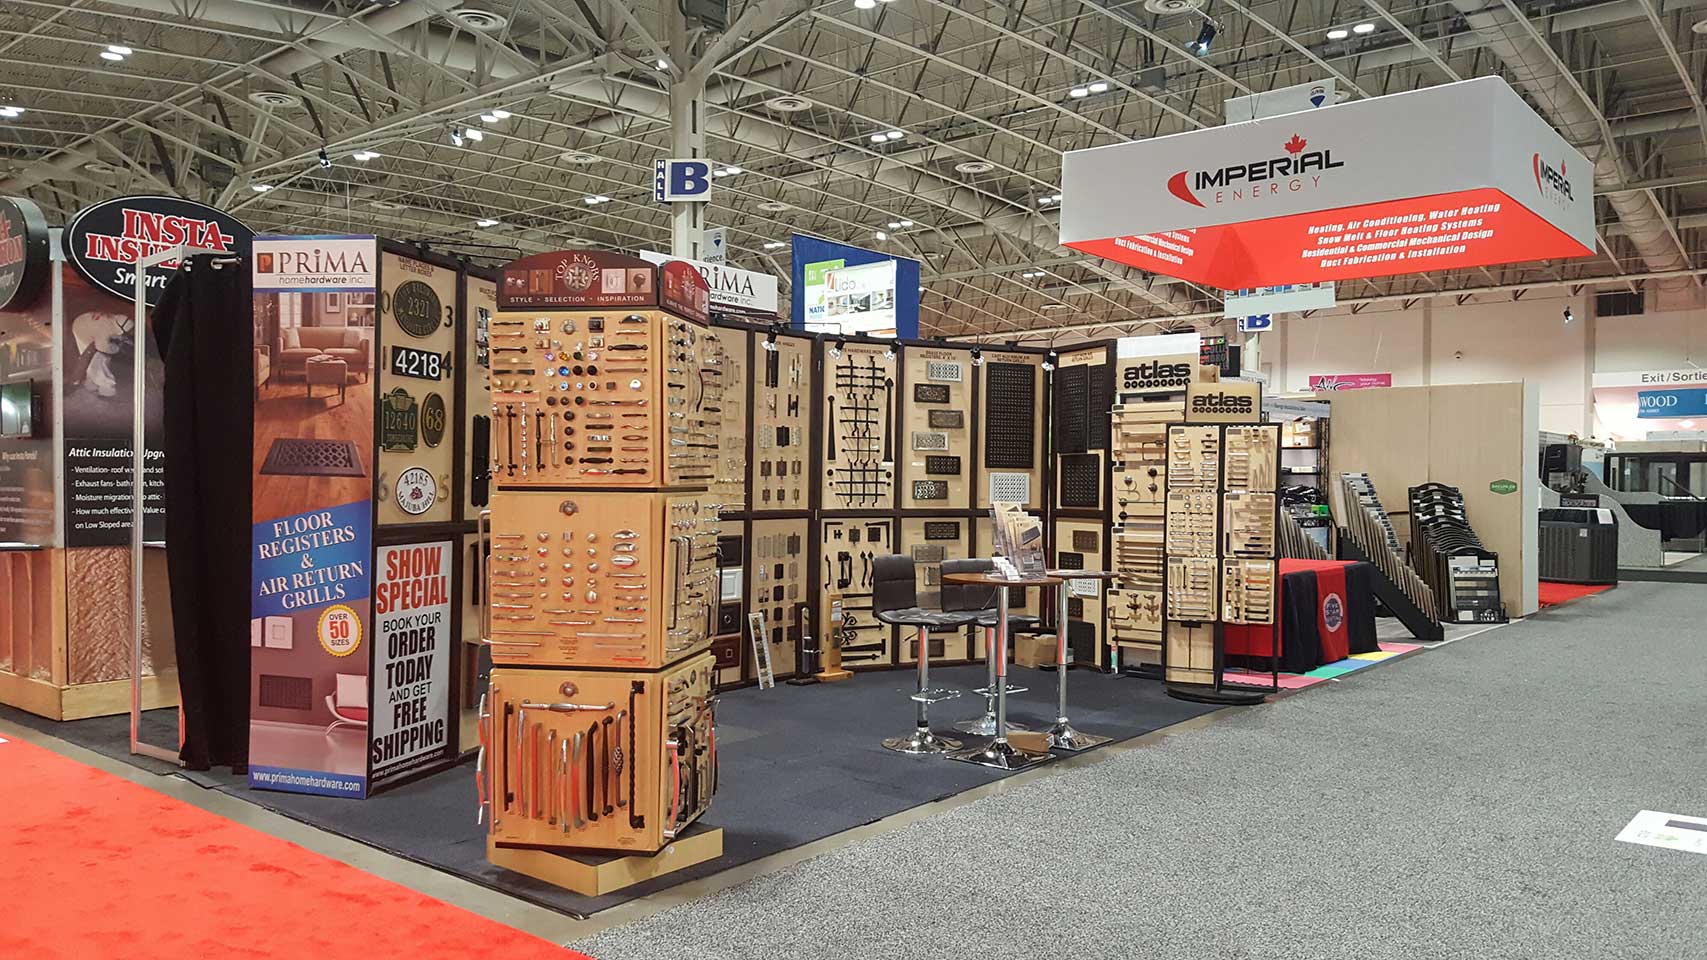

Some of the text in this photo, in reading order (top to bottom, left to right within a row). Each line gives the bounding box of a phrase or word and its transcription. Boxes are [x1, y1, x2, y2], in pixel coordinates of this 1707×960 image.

[656, 161, 664, 200] HALL
[671, 162, 709, 195] B
[1216, 176, 1320, 203] ENERGY
[122, 208, 234, 251] INSTA-
[1308, 203, 1500, 234] Heating, Air Conditioning, Water Heating
[1317, 218, 1482, 245] Snow Melt & Floor Heating Systems
[1302, 246, 1348, 258] Residential
[1357, 239, 1407, 252] Commercial
[1409, 232, 1460, 246] Mechanical
[1461, 229, 1494, 241] Design
[1320, 244, 1466, 268] Duct Fabrication & Installation
[114, 268, 167, 288] Smart
[279, 276, 347, 286] homehardware
[555, 254, 600, 281] TOP KNOBS
[408, 296, 430, 318] 2321
[444, 306, 453, 327] 3
[1248, 314, 1271, 328] B
[396, 350, 440, 377] 4218
[441, 351, 452, 378] 4
[1124, 360, 1190, 380] atlas
[1192, 392, 1252, 407] atlas
[426, 408, 444, 431] 68
[68, 448, 91, 457] Attic
[92, 448, 134, 458] Insulatio
[404, 472, 428, 486] 42185
[438, 474, 449, 502] 5
[99, 521, 120, 530] Sloped
[273, 512, 334, 538] FLOOR
[258, 525, 355, 560] REGISTERS
[301, 554, 314, 569] &
[386, 546, 442, 580] SHOW
[259, 560, 364, 596] AIR RETURN
[282, 584, 346, 609] GRILLS
[377, 576, 448, 614] SPECIAL
[330, 621, 349, 639] 50
[383, 612, 441, 633] BOOK YOUR
[388, 626, 435, 660] ORDER
[386, 654, 433, 690] TODAY
[389, 682, 432, 703] AND GET
[394, 697, 427, 730] FREE
[373, 718, 444, 764] SHIPPING
[372, 750, 444, 779] www.primahomehardware.com
[252, 770, 360, 792] www.primahomehardware.com
